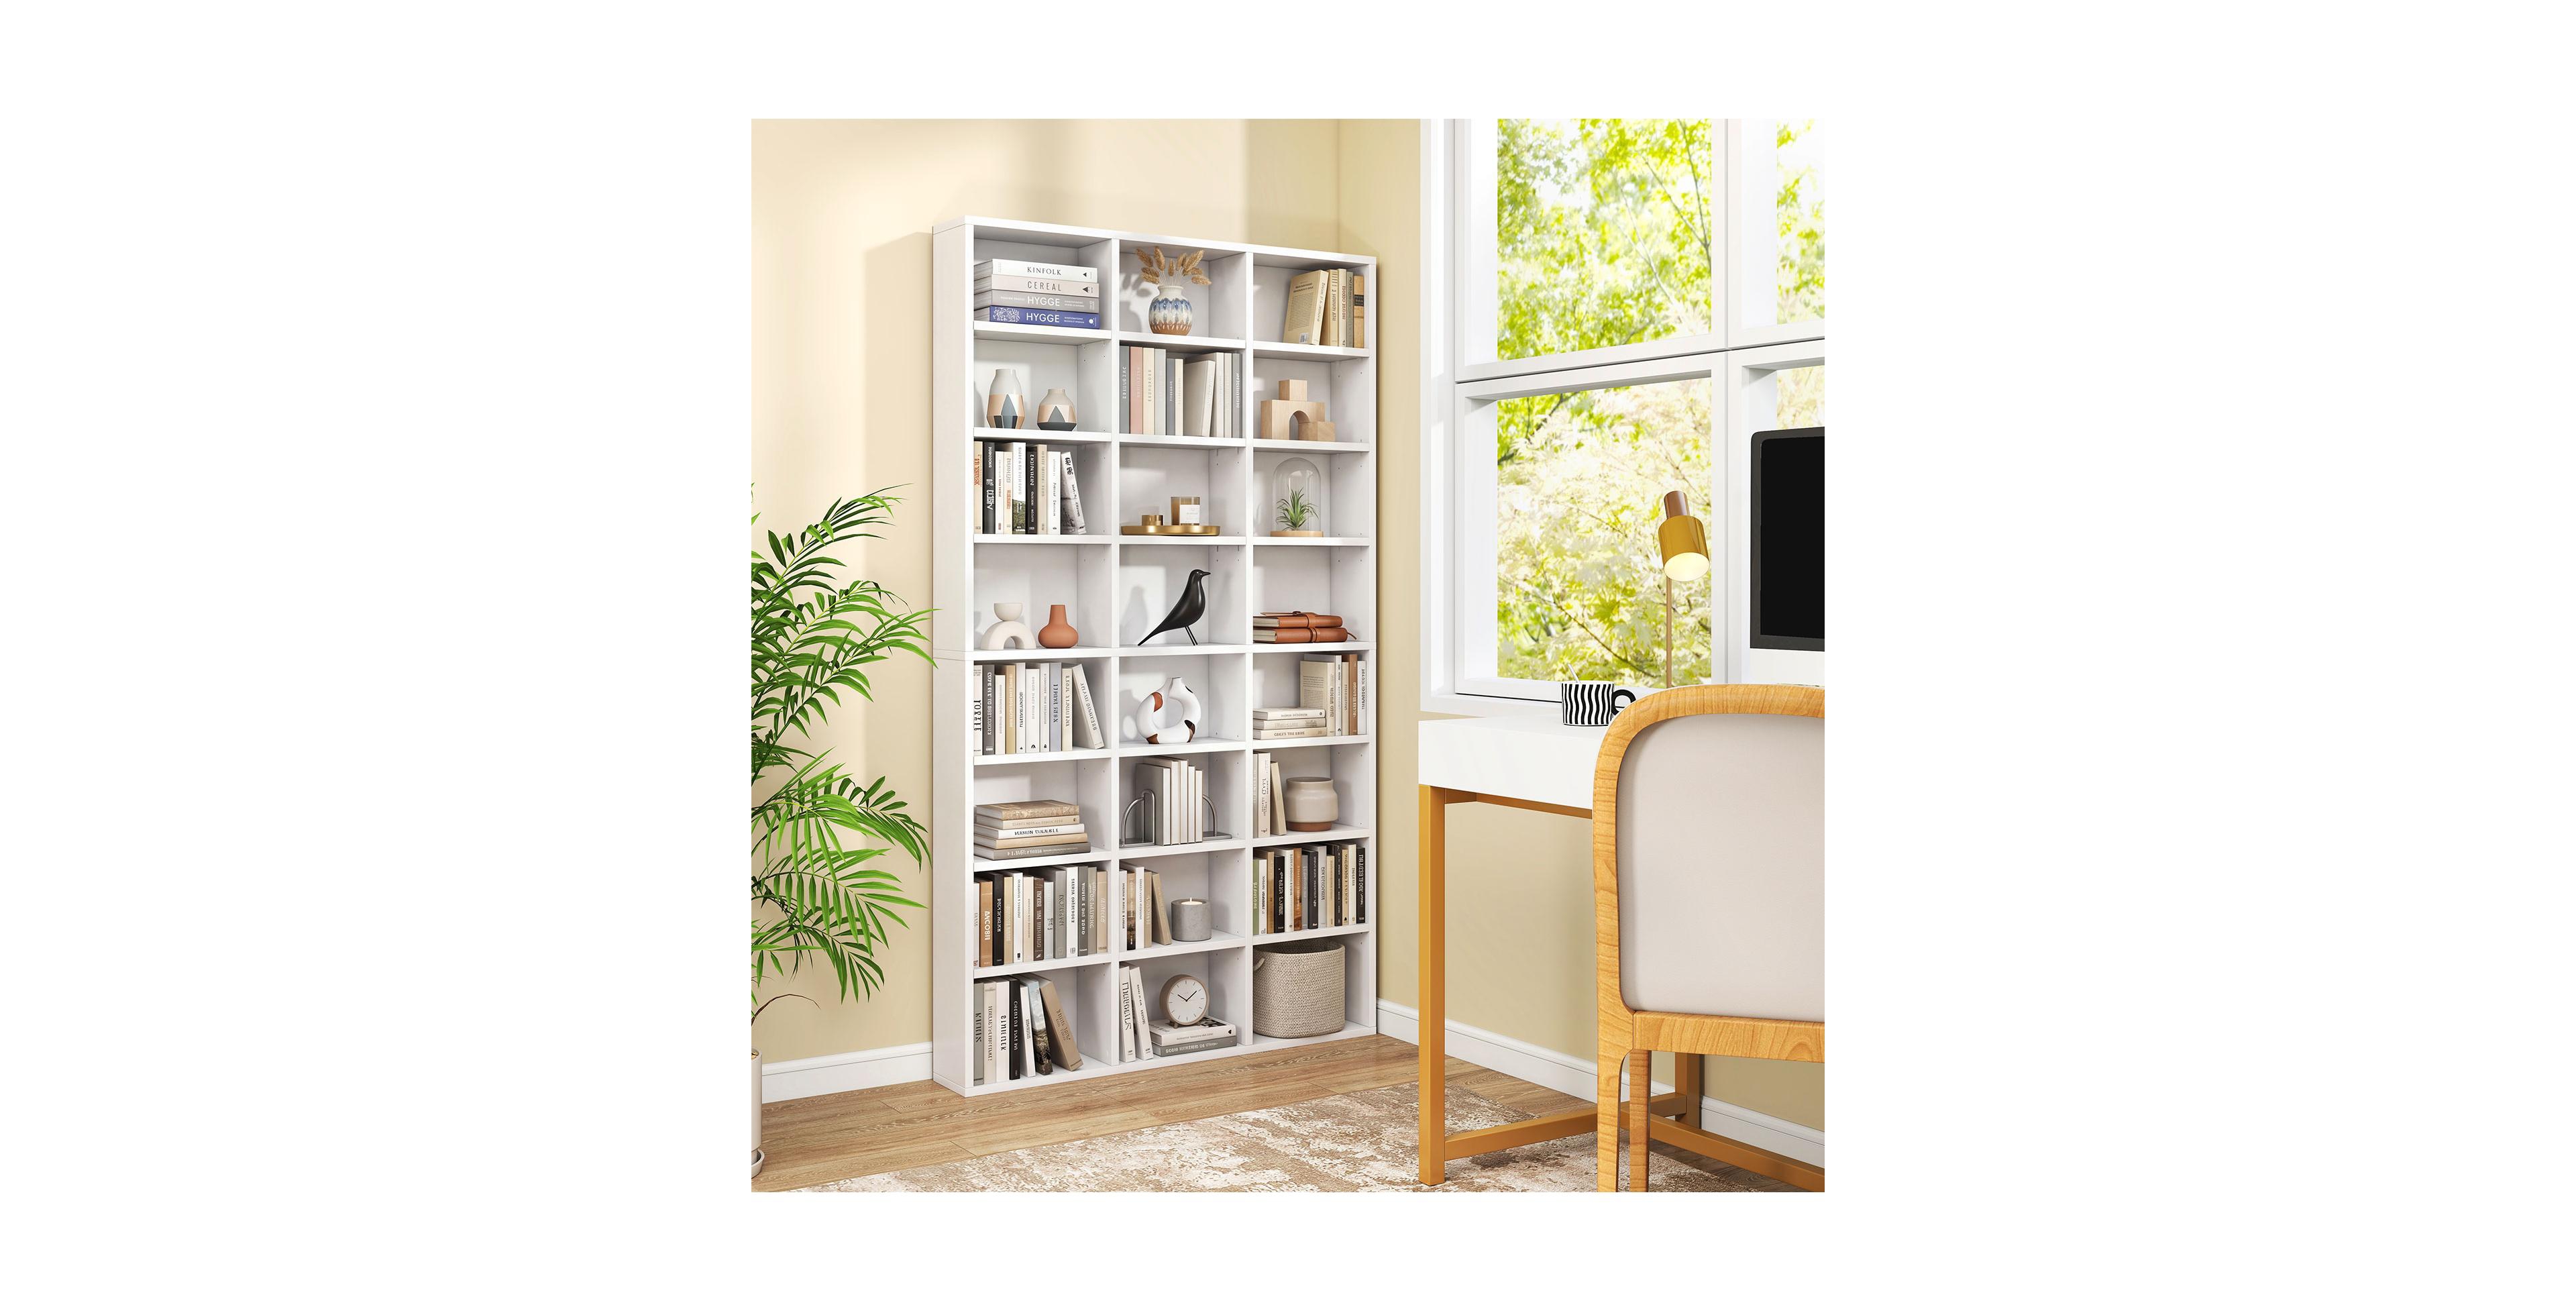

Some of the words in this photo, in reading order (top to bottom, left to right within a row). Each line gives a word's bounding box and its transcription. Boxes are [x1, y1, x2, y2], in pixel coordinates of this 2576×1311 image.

[1027, 266, 1062, 276] KINFOLK
[1027, 280, 1062, 291] CEREAL
[1027, 296, 1060, 307] HYGGE
[1026, 312, 1060, 323] HYGGE
